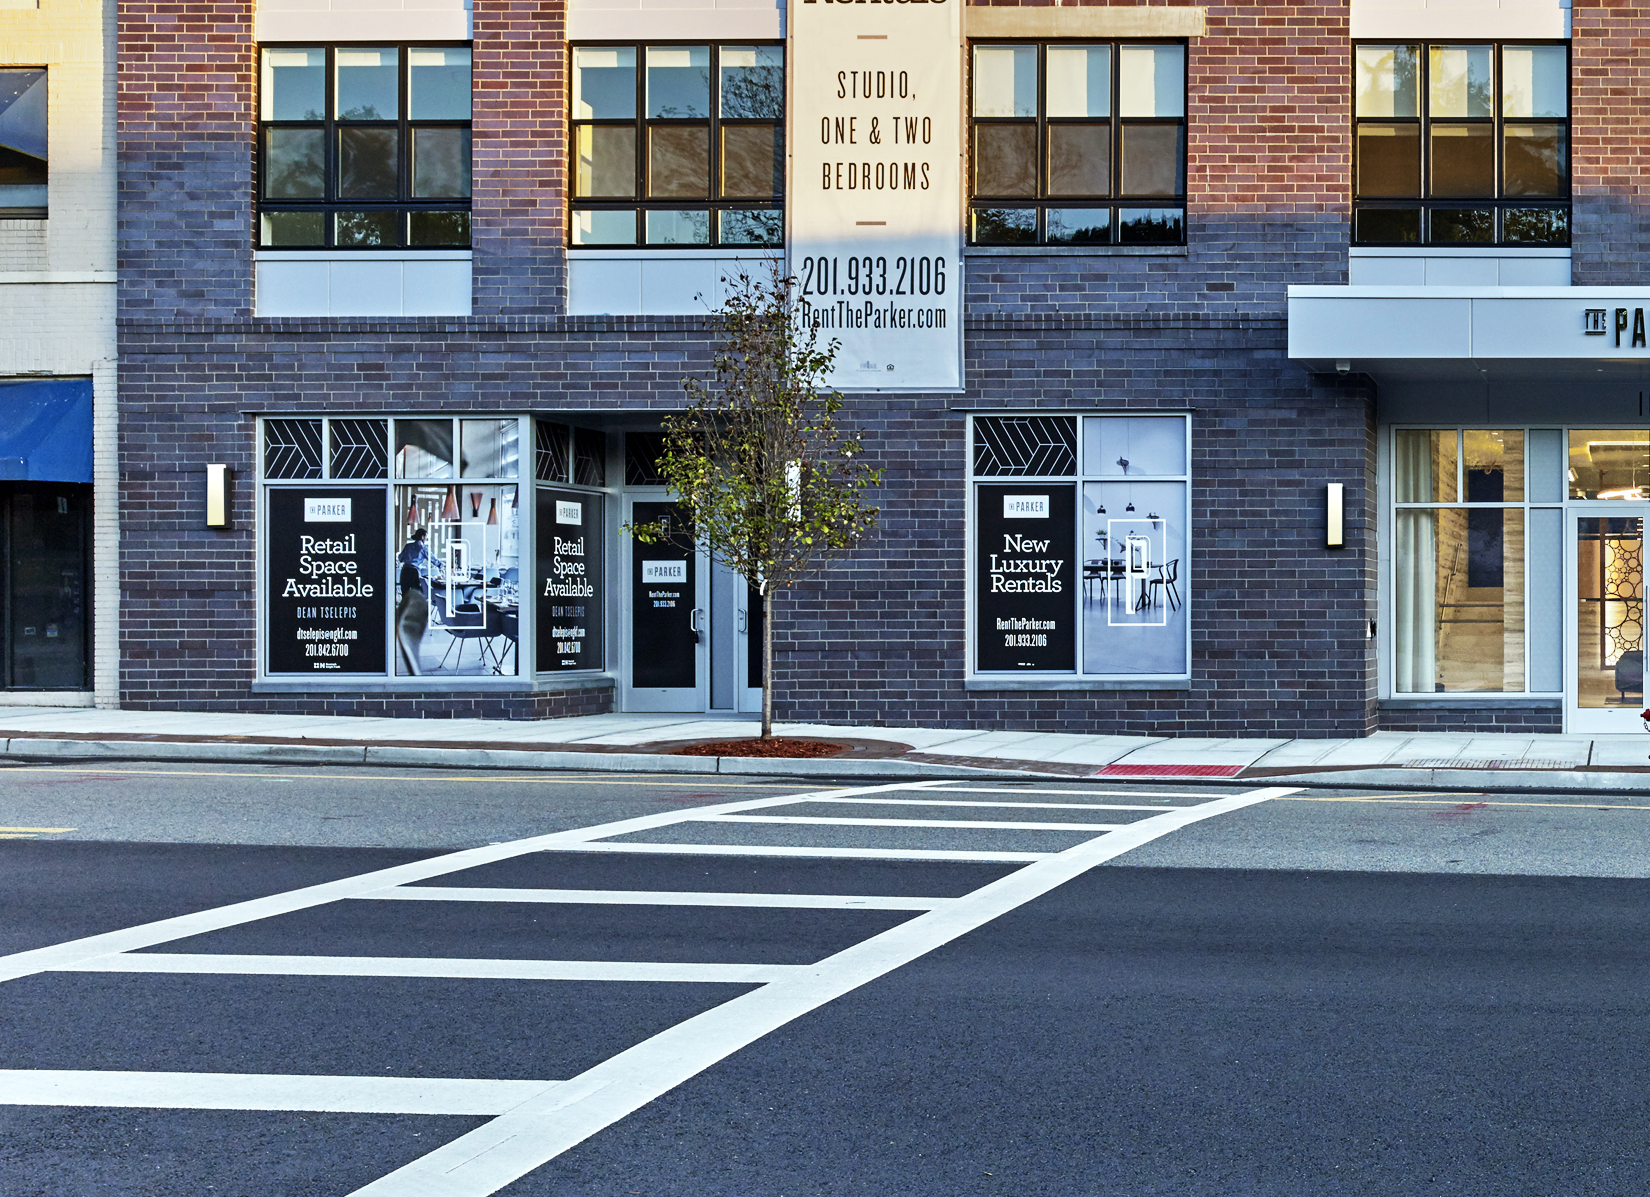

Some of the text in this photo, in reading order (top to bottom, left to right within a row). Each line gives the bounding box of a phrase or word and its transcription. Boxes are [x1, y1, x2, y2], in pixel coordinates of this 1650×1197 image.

[837, 70, 916, 101] STUDIO,
[821, 116, 932, 145] ONE & TWO
[822, 162, 930, 190] BEDROOMS
[802, 256, 946, 296] 201.933.2106
[802, 300, 947, 329] RentTheParker.com
[317, 504, 346, 516] PARKER
[1016, 501, 1044, 513] PARKER
[300, 534, 356, 554] Retail
[553, 536, 584, 556] Retail
[1003, 534, 1050, 553] New
[299, 556, 357, 579] Space
[553, 556, 585, 579] Space
[654, 566, 681, 577] PARKER
[990, 554, 1064, 577] Luxury
[1125, 535, 1152, 615] P
[282, 577, 373, 597] Available
[446, 539, 471, 617] P
[544, 577, 593, 597] Available
[990, 573, 1062, 593] Rentals
[297, 607, 357, 618] DEAN TSELEPIS
[996, 617, 1056, 631] RentTheParker.com
[297, 627, 358, 642] dtselepis@ngkf.com
[1004, 634, 1047, 647] 201.933.2106
[306, 644, 349, 657] 201.842.6700
